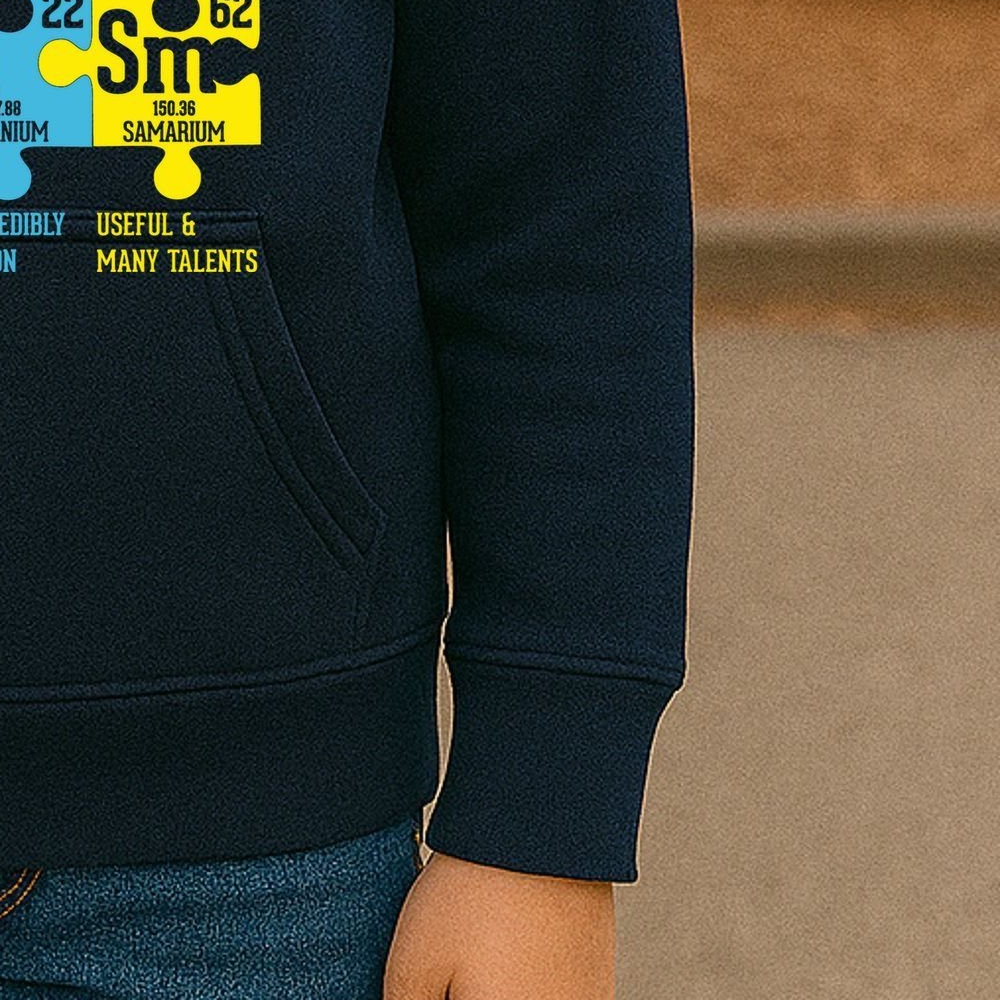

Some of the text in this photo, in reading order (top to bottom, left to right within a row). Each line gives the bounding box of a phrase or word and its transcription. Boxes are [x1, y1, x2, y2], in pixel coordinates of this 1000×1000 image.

[97, 8, 217, 94] Sm
[152, 100, 196, 116] 150.36
[123, 120, 225, 142] SAMARIUM
[96, 211, 196, 237] USEFUL &
[96, 248, 258, 273] MANY TALENTS
